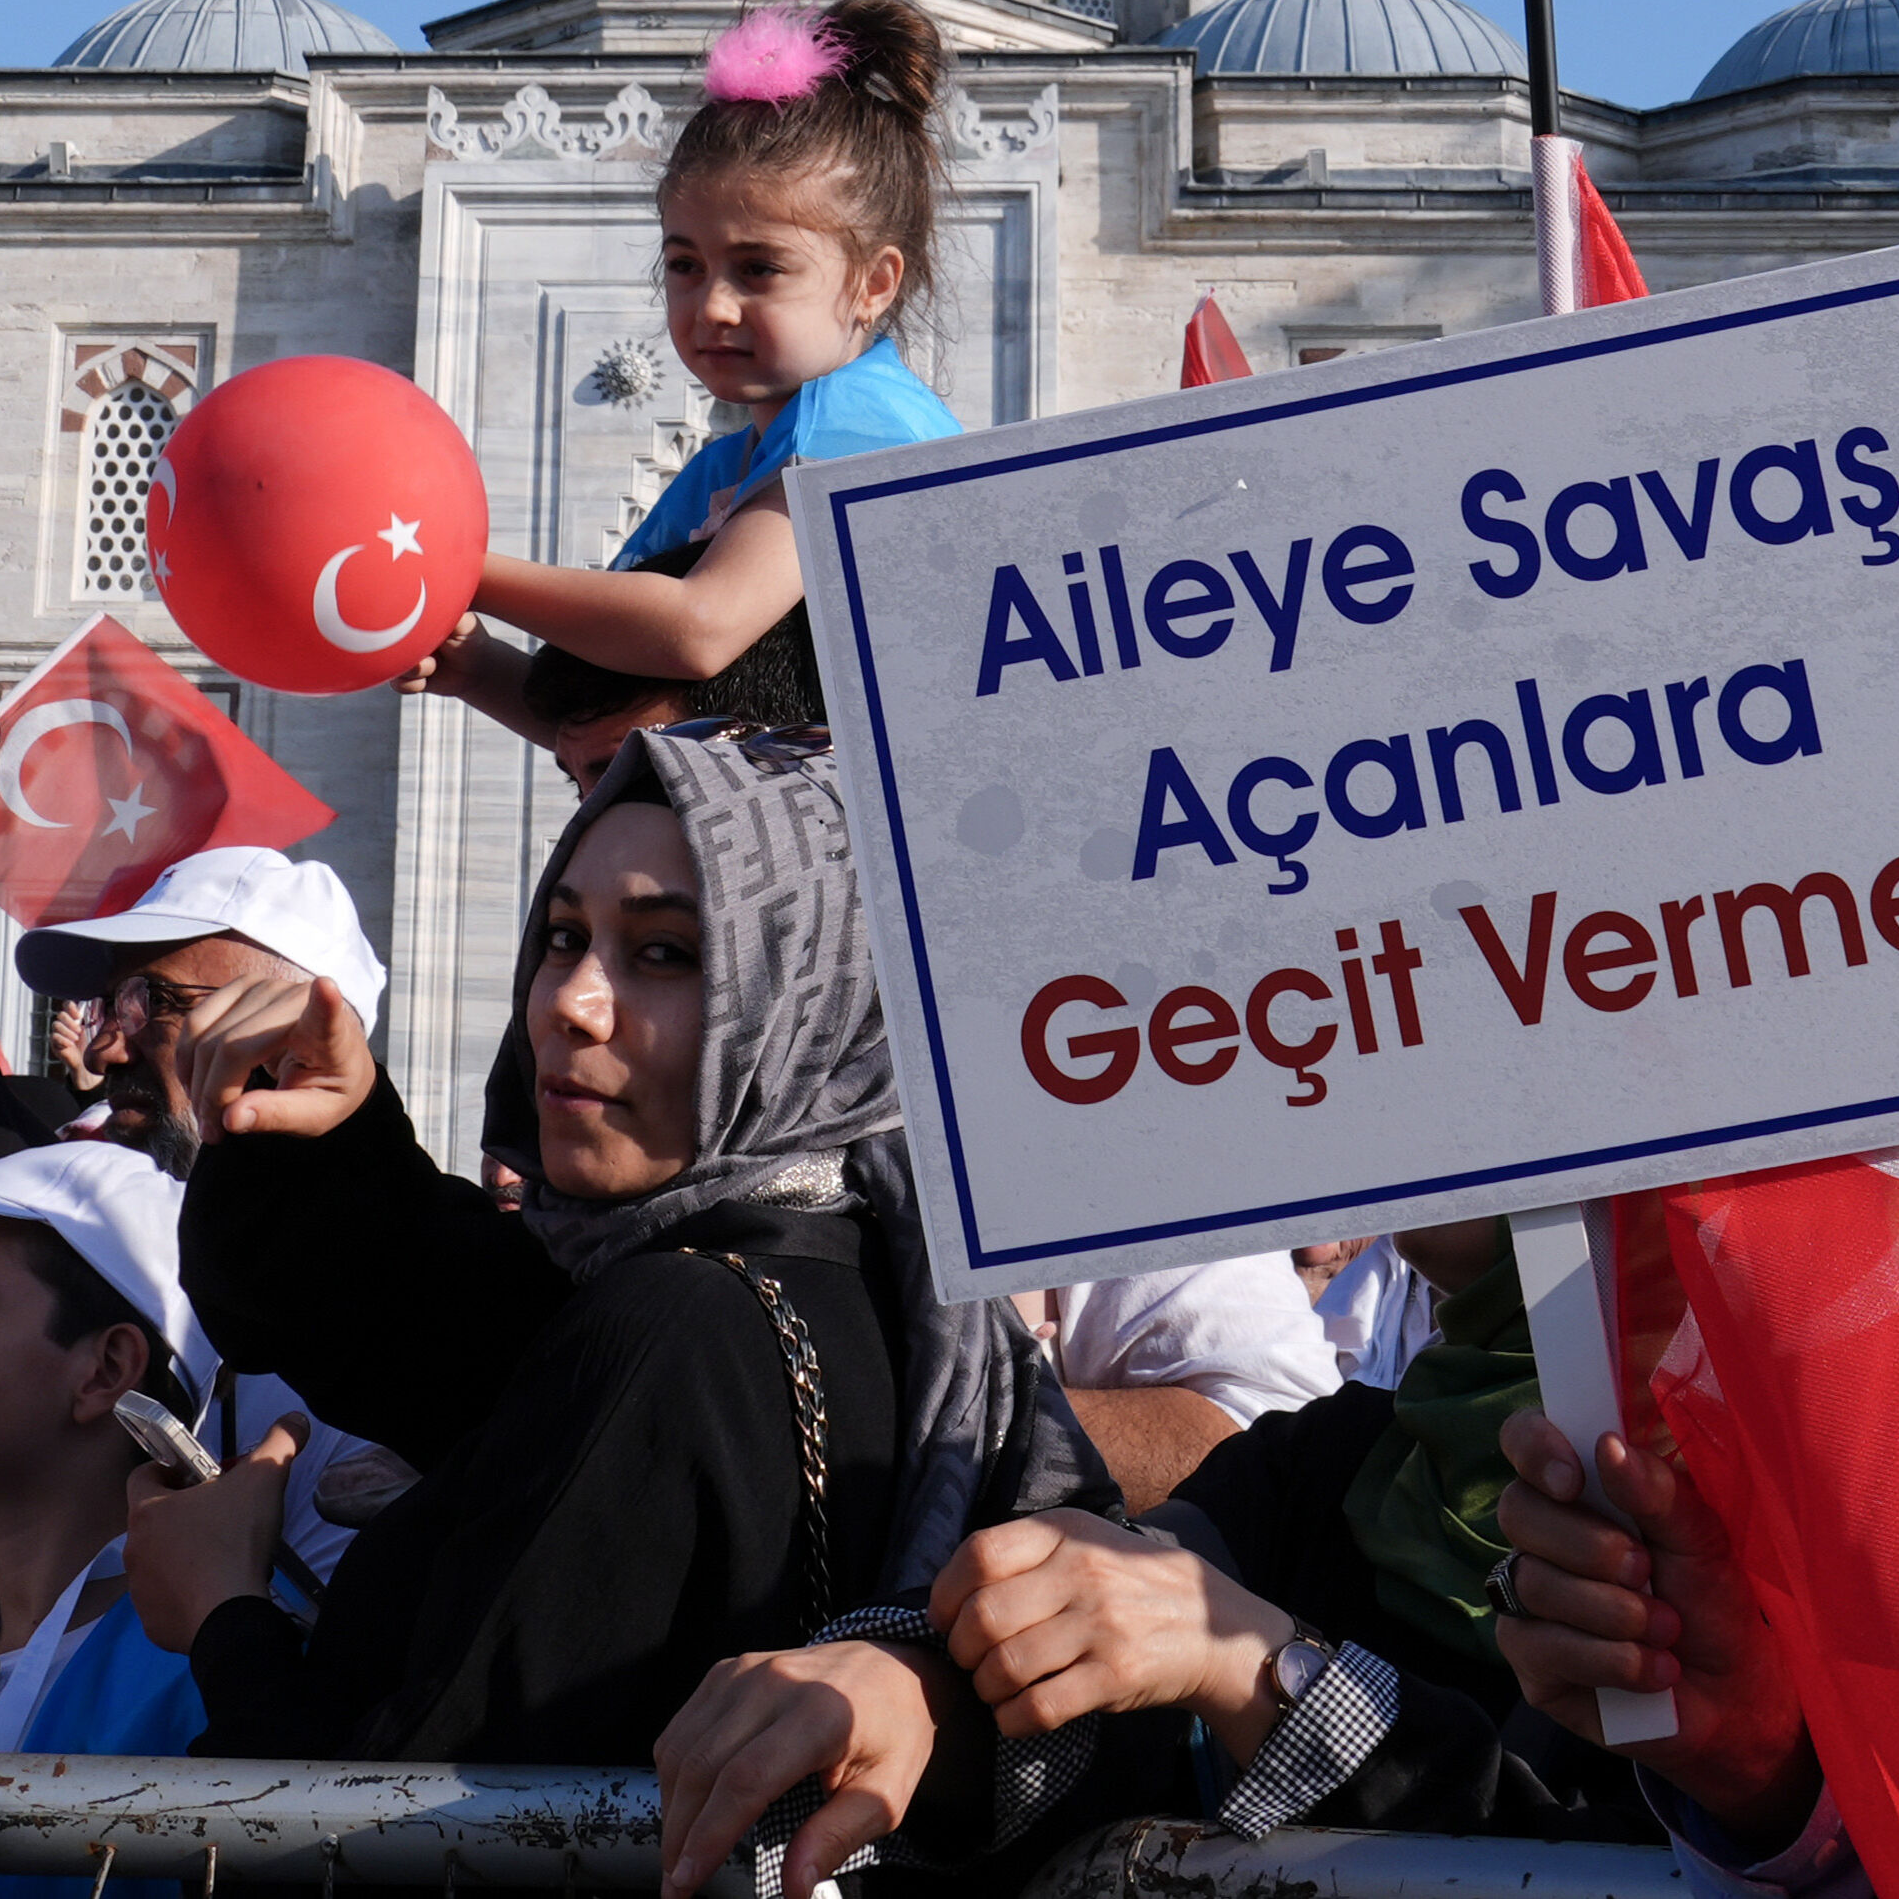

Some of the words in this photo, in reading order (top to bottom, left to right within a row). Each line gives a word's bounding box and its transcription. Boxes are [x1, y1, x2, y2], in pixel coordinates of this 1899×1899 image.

[974, 523, 1417, 698] Aileye
[1130, 657, 1824, 896] Açanlara
[1019, 918, 1426, 1108] Geçit
